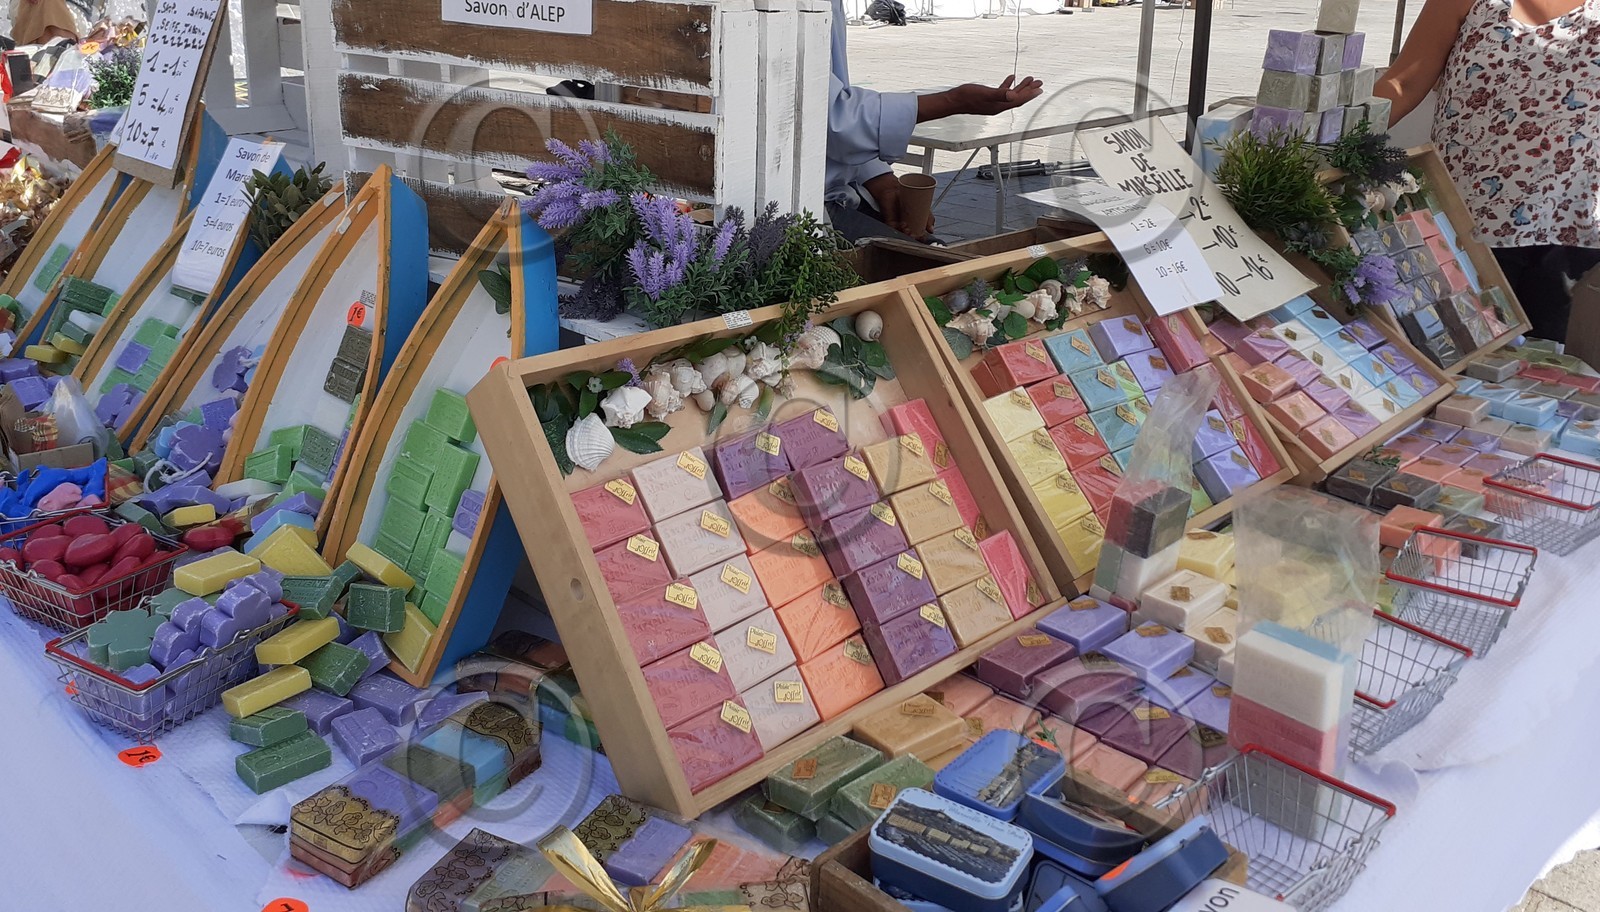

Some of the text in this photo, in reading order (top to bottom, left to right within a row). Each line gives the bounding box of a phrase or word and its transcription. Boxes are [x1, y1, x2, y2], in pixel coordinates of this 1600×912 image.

[465, 0, 566, 23] Savon d'ALEP
[1103, 127, 1152, 155] SAVON
[236, 147, 271, 163] Savon de
[1130, 152, 1157, 173] DE
[229, 197, 244, 208] euro
[217, 222, 234, 232] euros
[207, 246, 226, 258] euros
